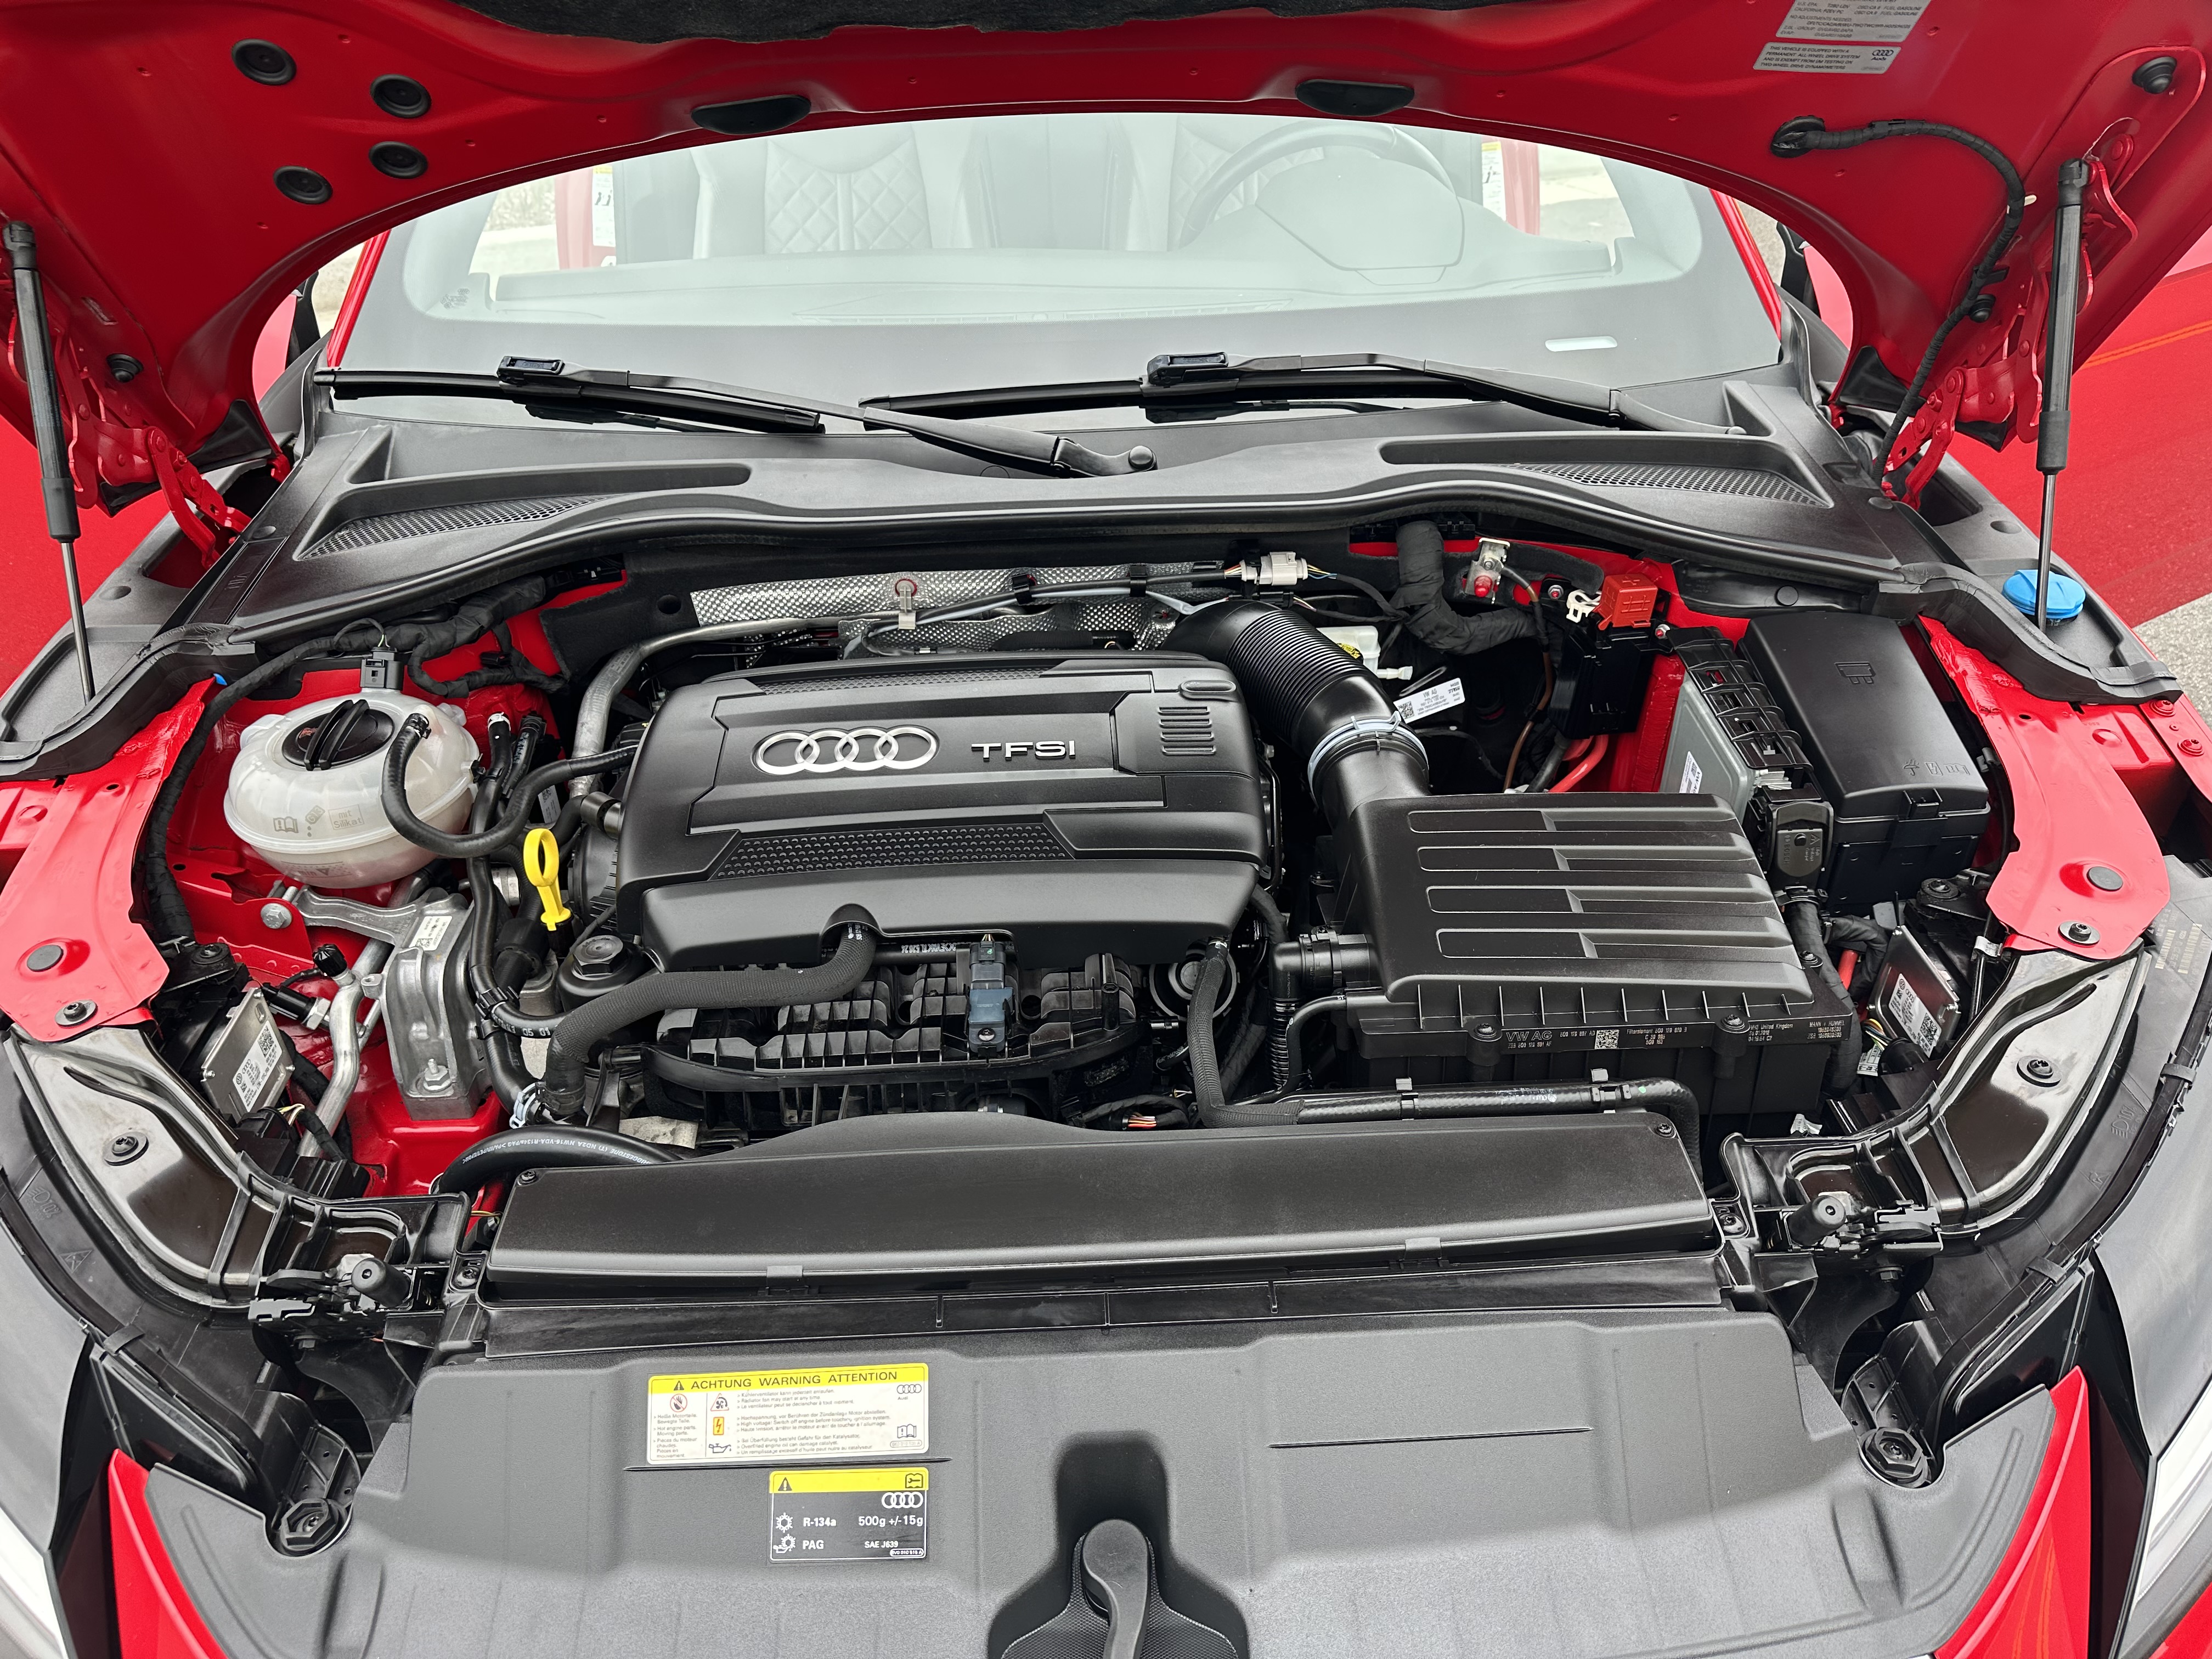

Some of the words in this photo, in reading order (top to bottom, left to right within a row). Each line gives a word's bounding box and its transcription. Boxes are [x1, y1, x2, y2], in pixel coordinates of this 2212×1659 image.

[971, 740, 1076, 761] TFSI
[307, 807, 323, 822] G13
[338, 809, 352, 819] mit
[333, 817, 363, 828] Silikat
[522, 1028, 534, 1036] 05
[1505, 1031, 1530, 1042] VW
[1531, 1030, 1553, 1041] AG
[578, 1141, 596, 1149] ND2A
[691, 1378, 752, 1390] ACHTUNG
[759, 1375, 821, 1386] WARNING
[827, 1371, 898, 1383] ATTENTION
[803, 1517, 837, 1527] R-134a
[858, 1515, 886, 1527] 500g
[803, 1540, 824, 1550] PAG
